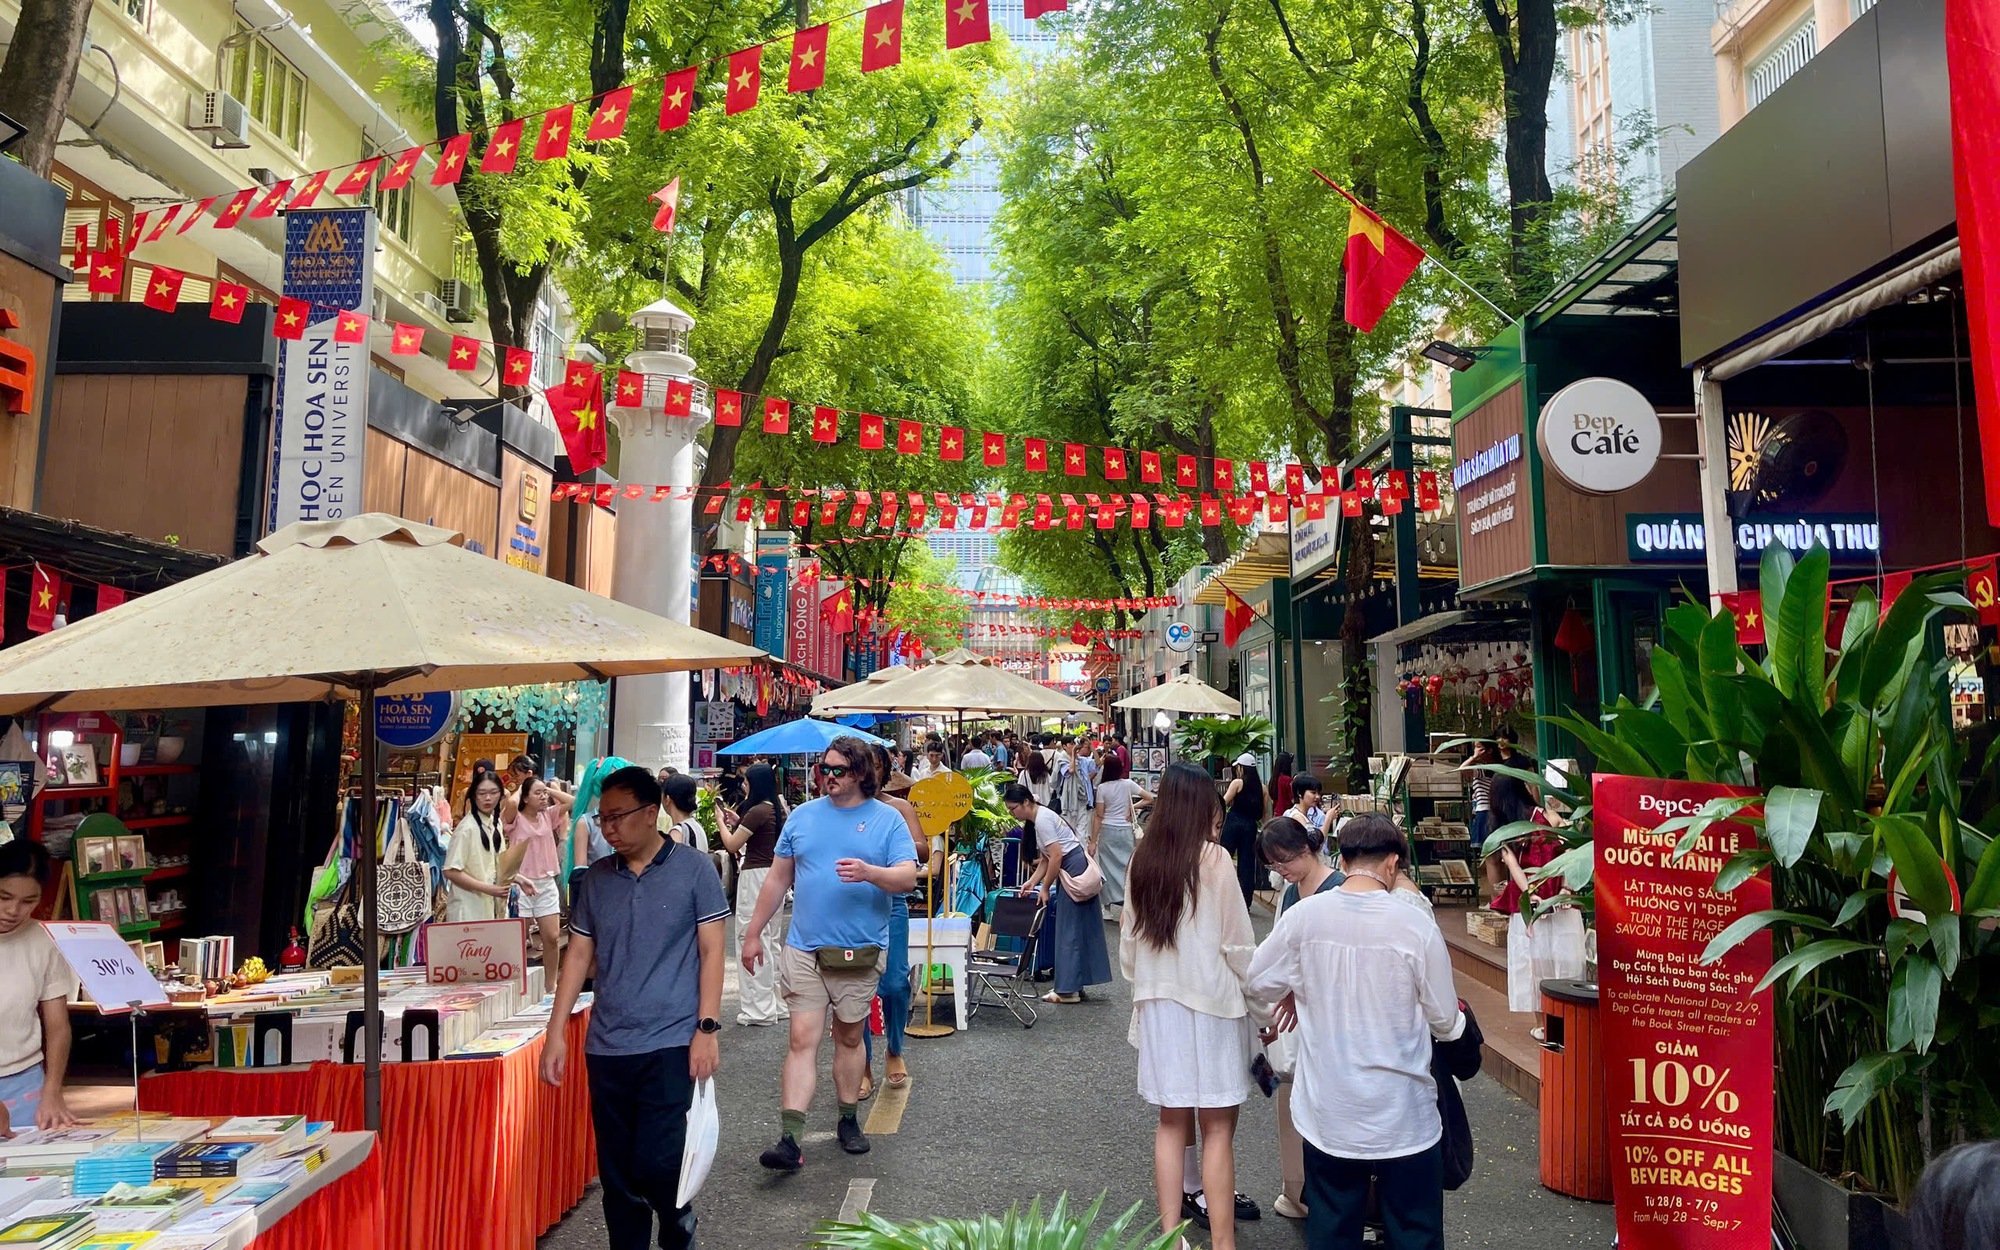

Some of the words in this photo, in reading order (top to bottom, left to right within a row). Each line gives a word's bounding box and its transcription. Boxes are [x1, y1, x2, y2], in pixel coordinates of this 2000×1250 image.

[291, 256, 325, 267] HOA
[329, 255, 356, 267] SEN
[292, 269, 353, 279] UNIVERSITY
[307, 338, 329, 384] SEN
[330, 342, 350, 463] UNIVERSIT
[304, 392, 325, 452] HOA
[1573, 413, 1616, 434] Đẹp
[1570, 424, 1640, 455] Café
[300, 461, 327, 521] HỌC
[327, 476, 344, 519] SEN
[1636, 519, 1704, 551] QUÁN
[1832, 524, 1879, 550] THU
[793, 597, 808, 640] ĐÔNG
[794, 643, 807, 668] ÁCH
[379, 716, 431, 724] UNIVERSITY
[380, 704, 408, 715] HOA
[410, 704, 433, 716] SEN
[1695, 834, 1714, 854] ẠI
[1720, 833, 1740, 854] LỄ
[1604, 846, 1654, 867] QUỐC
[1624, 878, 1645, 894] LẬT
[1649, 882, 1693, 898] TRANG
[1624, 895, 1680, 912] THƯỞNG
[1684, 902, 1697, 915] VỊ
[1701, 904, 1737, 917] "ĐẸP"
[1615, 923, 1662, 938] SAVOUR
[1666, 928, 1688, 941] THE
[1630, 912, 1662, 925] TURN
[1666, 915, 1688, 928] THE
[1692, 918, 1724, 932] PAGE
[456, 939, 493, 963] Tặng
[1636, 949, 1664, 963] Mừng
[1667, 952, 1685, 964] Đại
[91, 958, 135, 976] 30%
[432, 965, 467, 983] 50%
[485, 962, 521, 980] 80%
[1613, 959, 1631, 973] Đẹp
[1634, 961, 1657, 973] Cafe
[1659, 963, 1685, 976] khao
[1688, 966, 1708, 979] bạn
[1711, 969, 1730, 982] đọc
[1733, 971, 1754, 984] ghé
[1626, 973, 1643, 985] Hội
[1645, 975, 1669, 987] Sách
[1672, 977, 1706, 993] Đường
[1709, 981, 1738, 995] Sách:
[1607, 988, 1616, 999] To
[1618, 988, 1661, 1003] celebrate
[1664, 993, 1708, 1008] National
[1711, 999, 1732, 1012] Day
[1735, 1001, 1762, 1016] 2/9,
[1612, 1002, 1630, 1015] Đẹp
[1632, 1003, 1655, 1015] Cafe
[1658, 1006, 1685, 1019] treats
[1688, 1008, 1701, 1020] all
[1703, 1011, 1742, 1025] readers
[1745, 1017, 1756, 1027] at
[1632, 1016, 1646, 1028] the
[1649, 1018, 1673, 1031] Book
[1676, 1022, 1705, 1034] Street
[1708, 1025, 1731, 1037] Fair:
[1655, 1039, 1699, 1057] GIẢM
[1628, 1058, 1740, 1113] 10%
[1620, 1108, 1641, 1127] TẤT
[1645, 1111, 1664, 1128] CẢ
[1699, 1117, 1751, 1139] UỐNG
[1624, 1146, 1658, 1164] 10%
[1665, 1147, 1705, 1168] OFF
[1713, 1153, 1752, 1176] ALL
[1630, 1168, 1743, 1195] BEVERAGES
[1645, 1195, 1655, 1207] Từ
[1657, 1195, 1683, 1208] 28/8
[1695, 1199, 1719, 1213] 7/9
[1633, 1211, 1651, 1223] From
[1652, 1211, 1669, 1225] Aug
[1672, 1211, 1688, 1223] 28
[1702, 1215, 1729, 1231] Sept
[1731, 1219, 1742, 1231] 7
